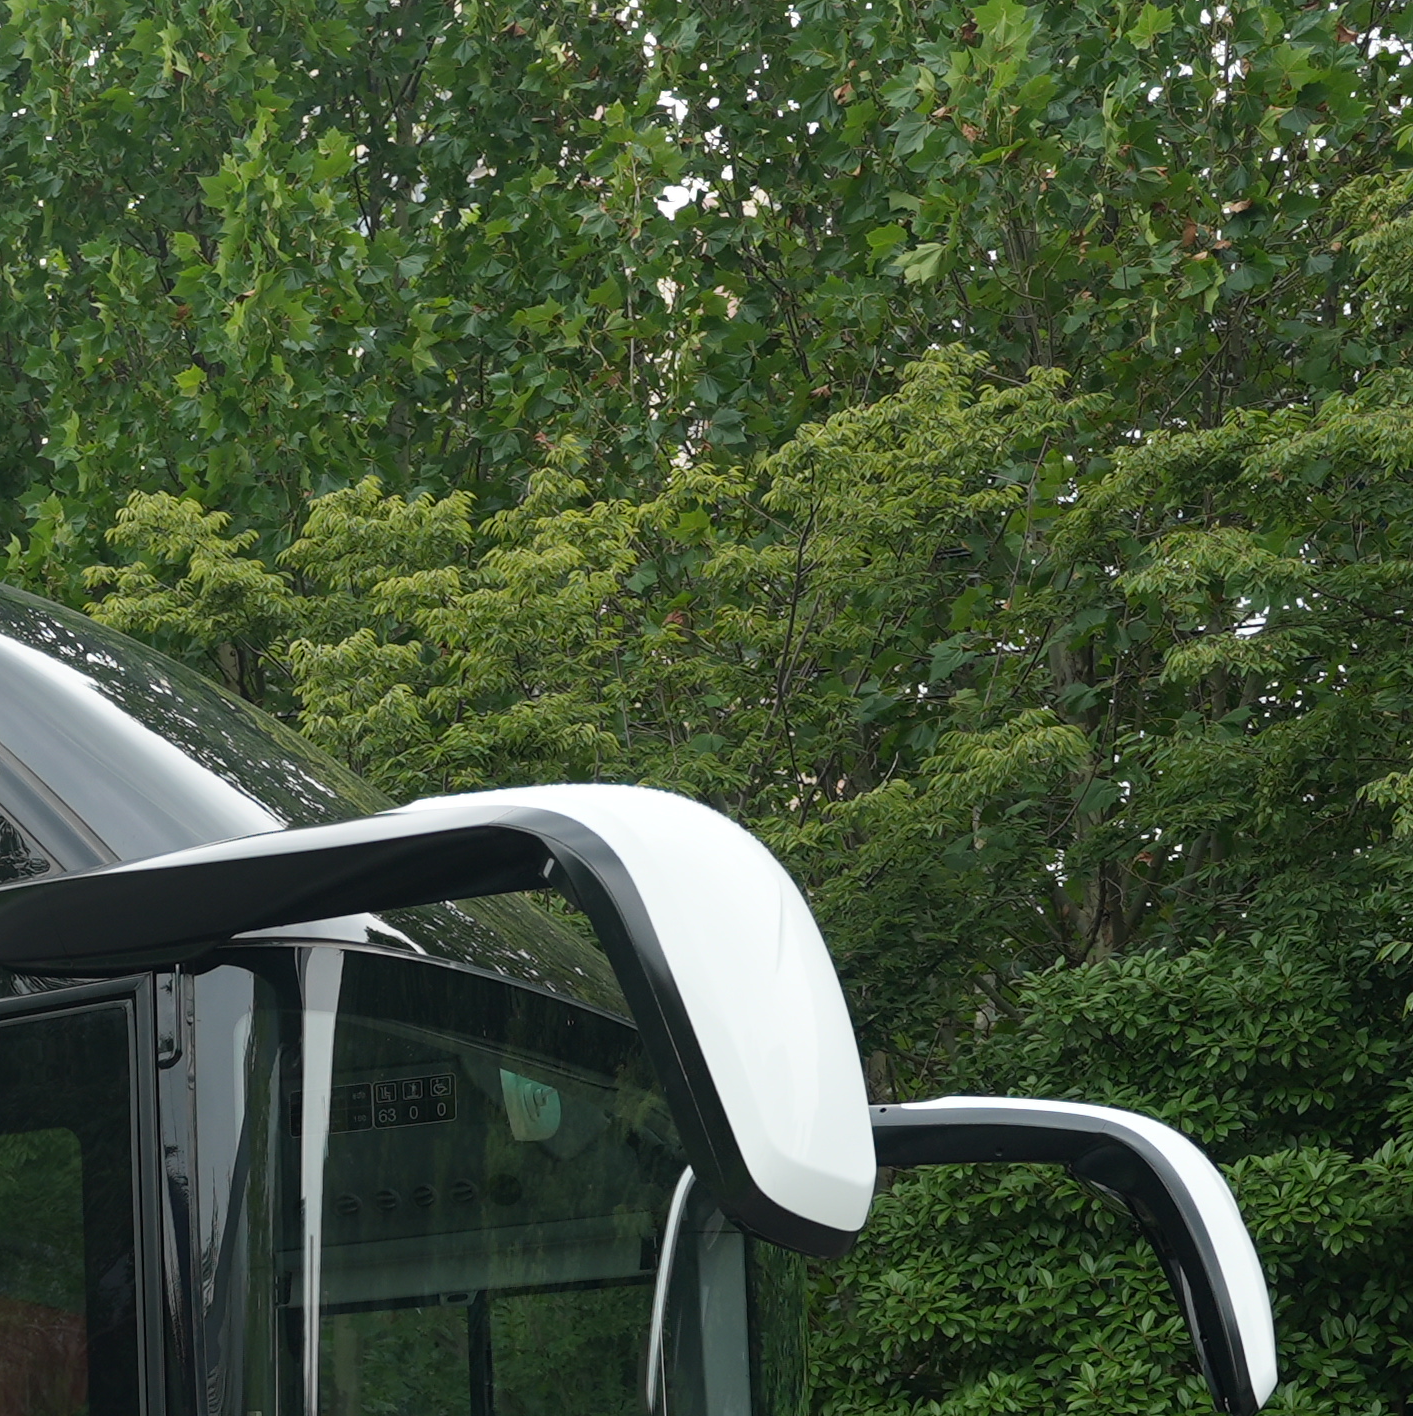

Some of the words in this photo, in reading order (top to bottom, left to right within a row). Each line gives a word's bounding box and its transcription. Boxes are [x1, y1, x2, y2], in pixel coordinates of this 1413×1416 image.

[378, 1108, 397, 1123] 63
[408, 1105, 419, 1120] 0
[436, 1102, 447, 1117] 0
